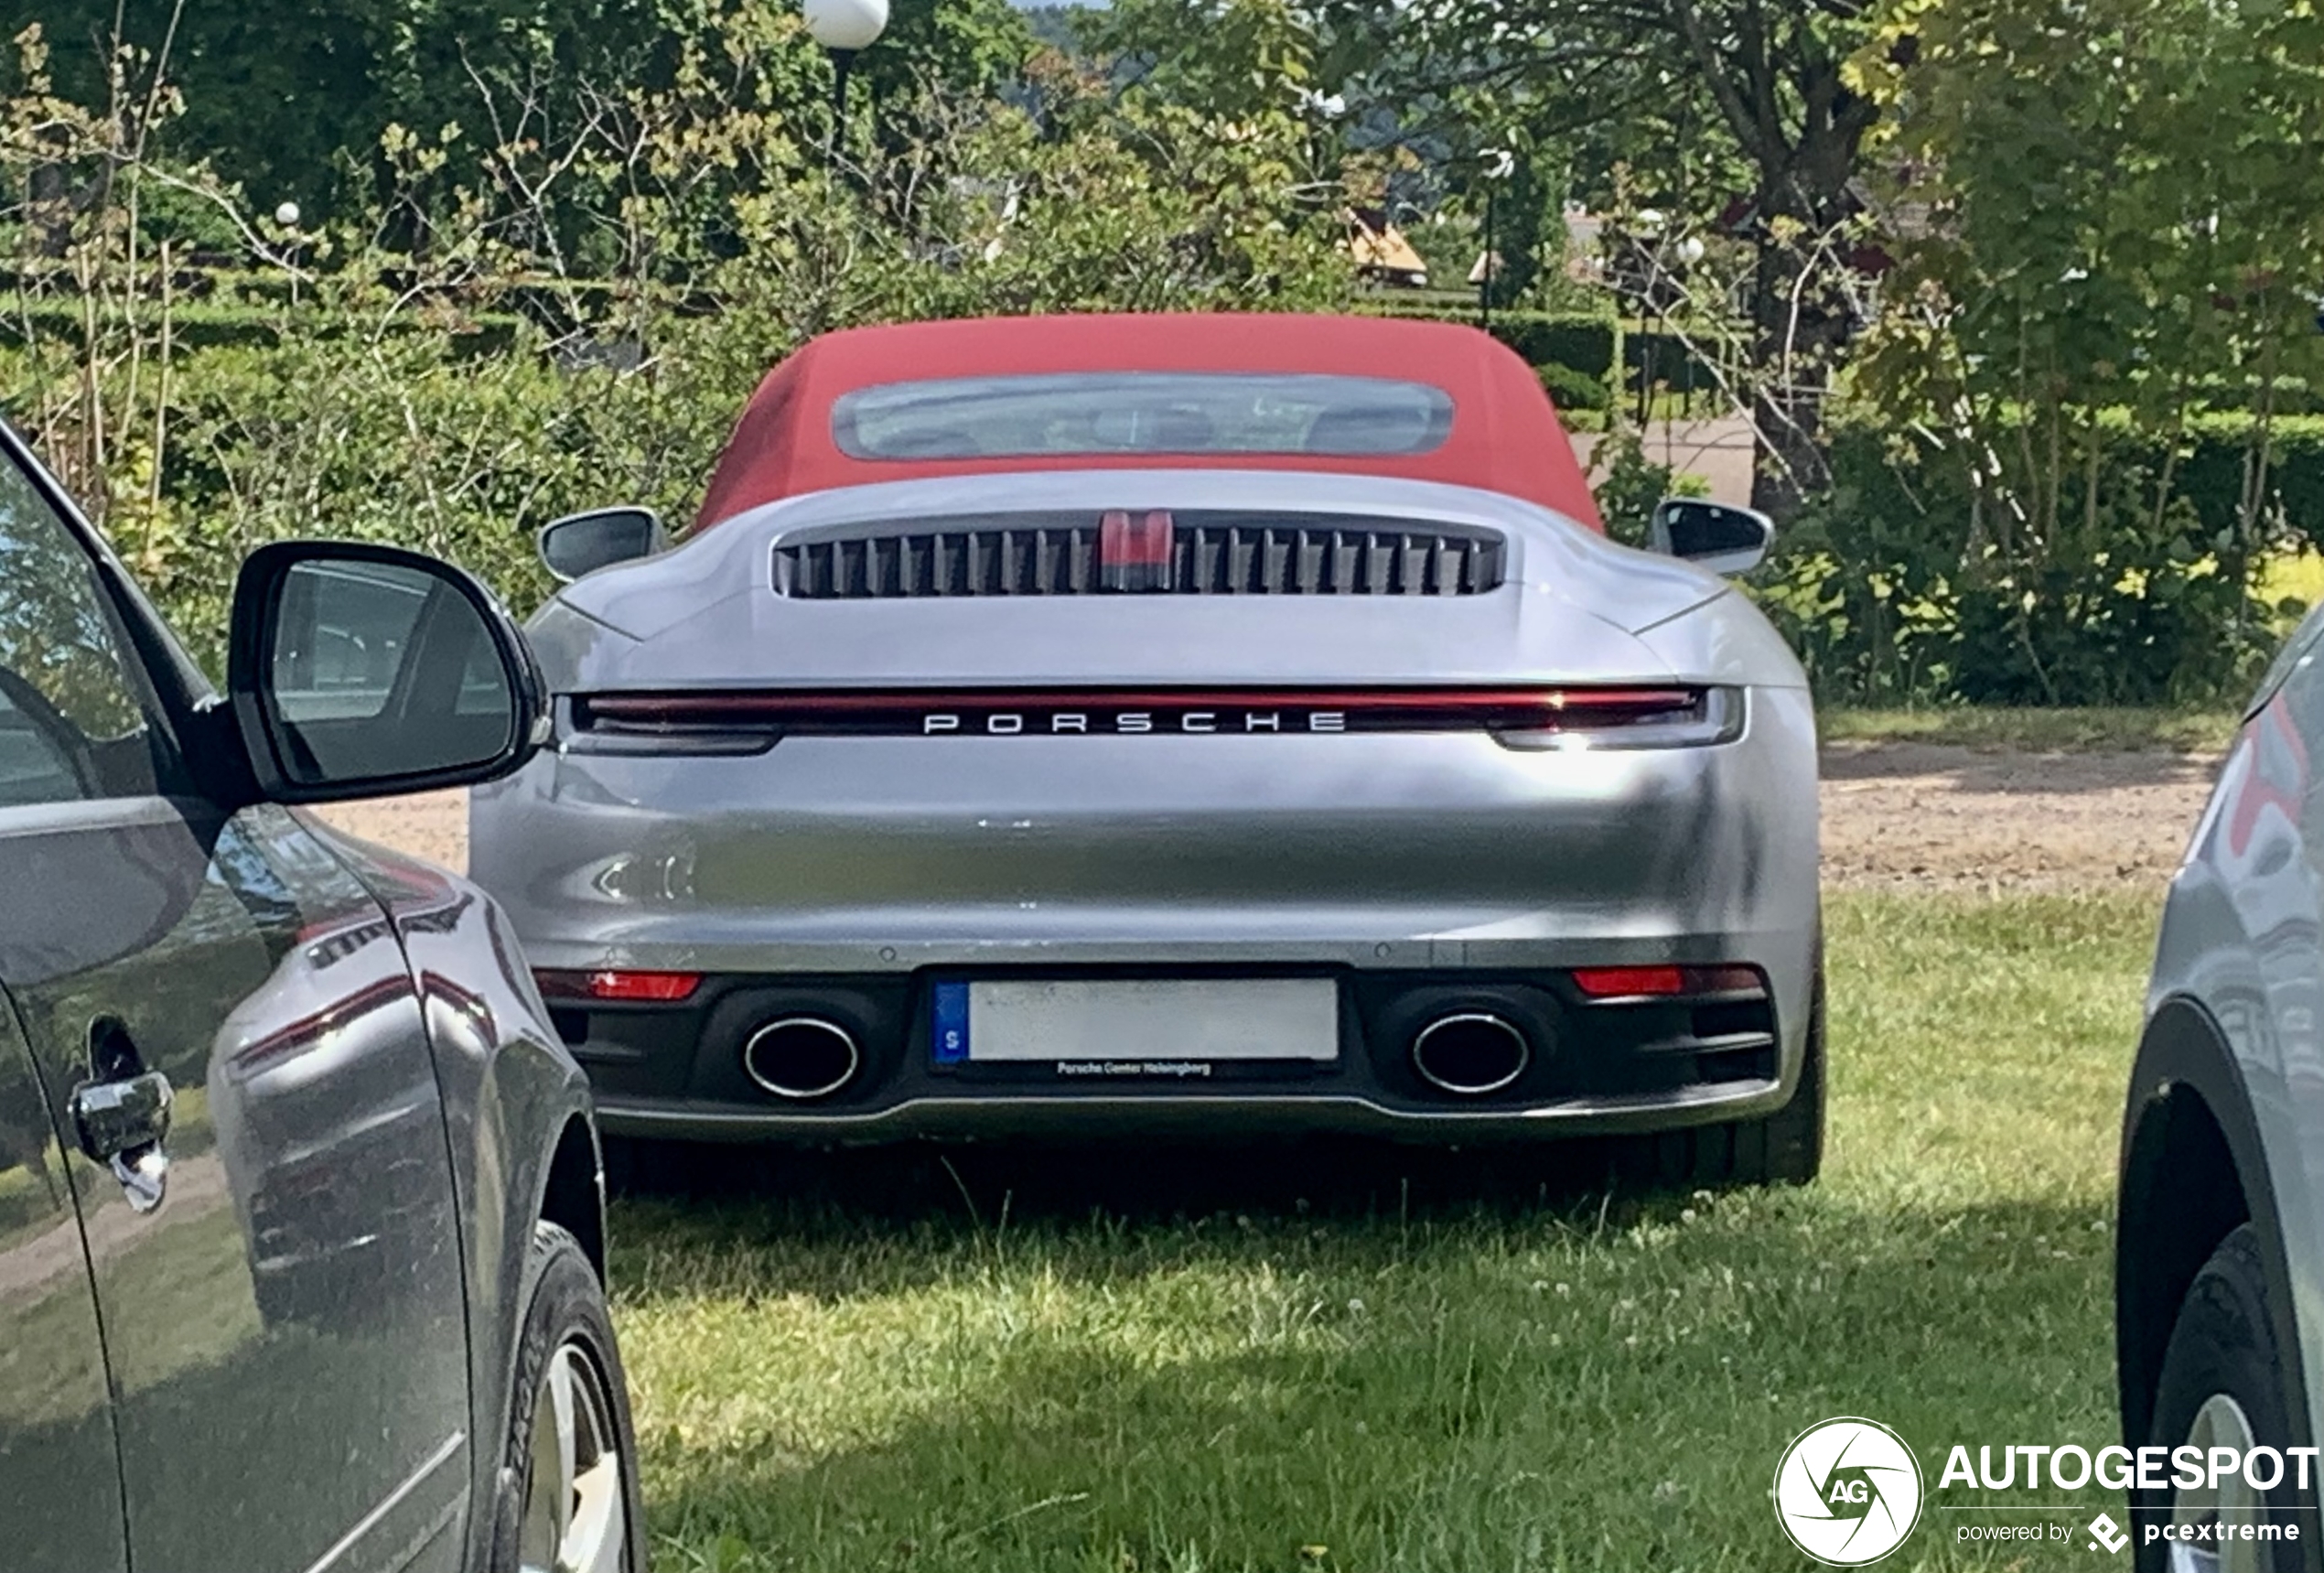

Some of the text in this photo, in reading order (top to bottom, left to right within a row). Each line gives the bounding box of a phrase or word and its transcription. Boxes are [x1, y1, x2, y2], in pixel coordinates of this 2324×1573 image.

[923, 713, 1346, 734] PORSCHE
[944, 1030, 960, 1050] S
[1058, 1061, 1103, 1074] Porsche
